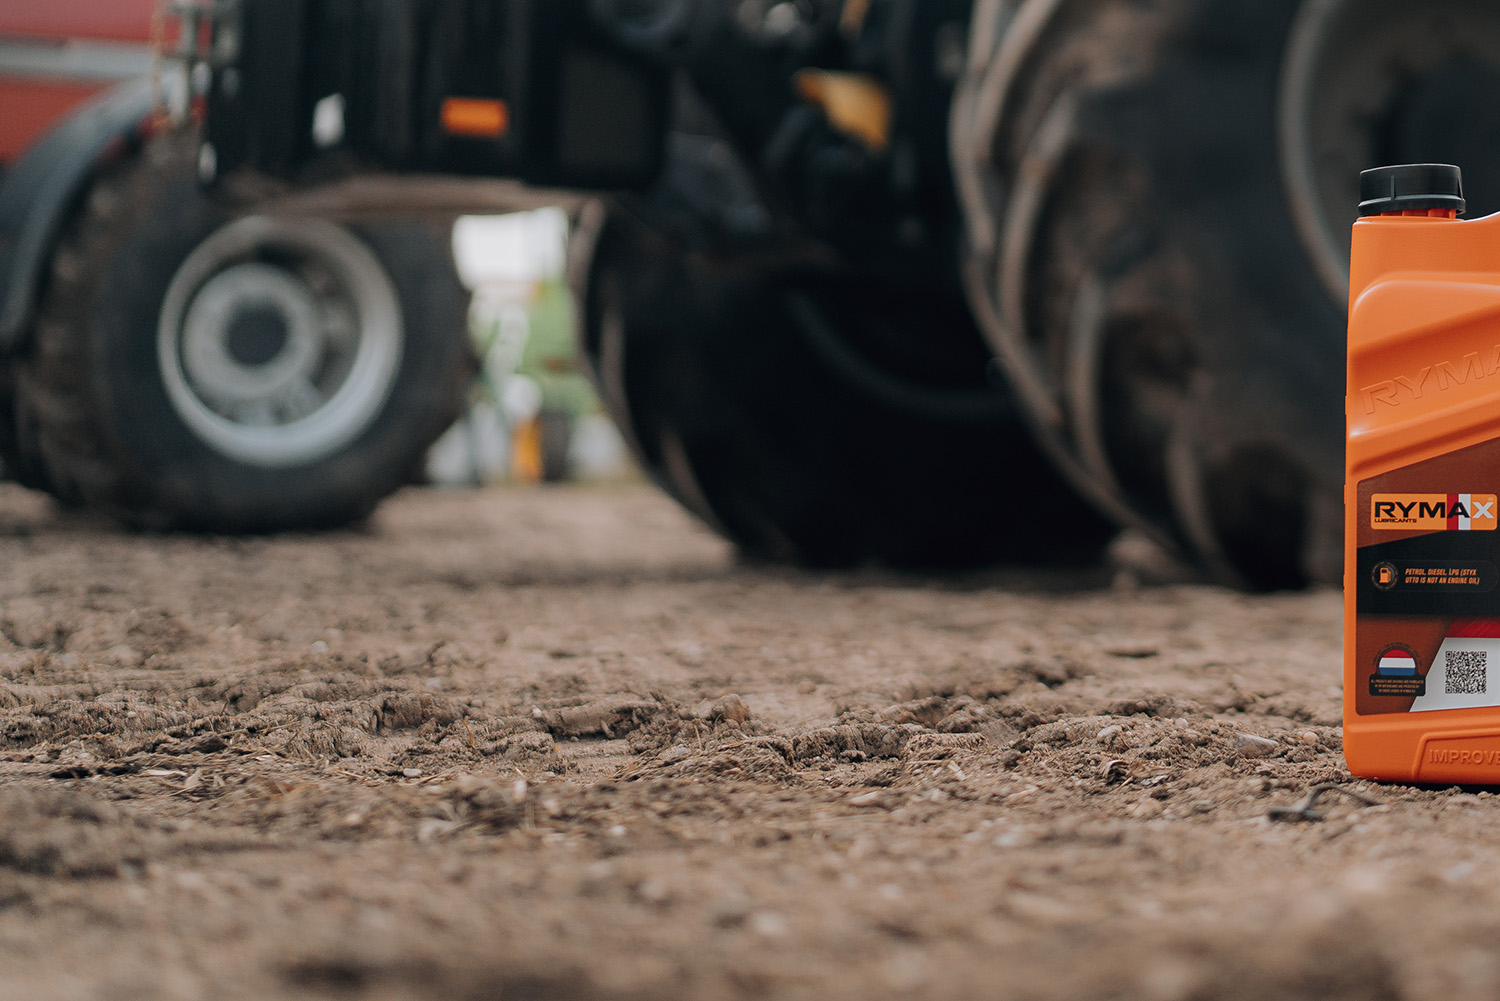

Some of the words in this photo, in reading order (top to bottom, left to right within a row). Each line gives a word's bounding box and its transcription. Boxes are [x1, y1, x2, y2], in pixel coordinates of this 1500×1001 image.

[1374, 502, 1494, 518] RYMAX
[1460, 568, 1477, 576] (STYX
[1405, 576, 1419, 584] UTTO
[1419, 576, 1426, 584] IS
[1427, 576, 1438, 584] NOT
[1468, 577, 1480, 585] OIL)
